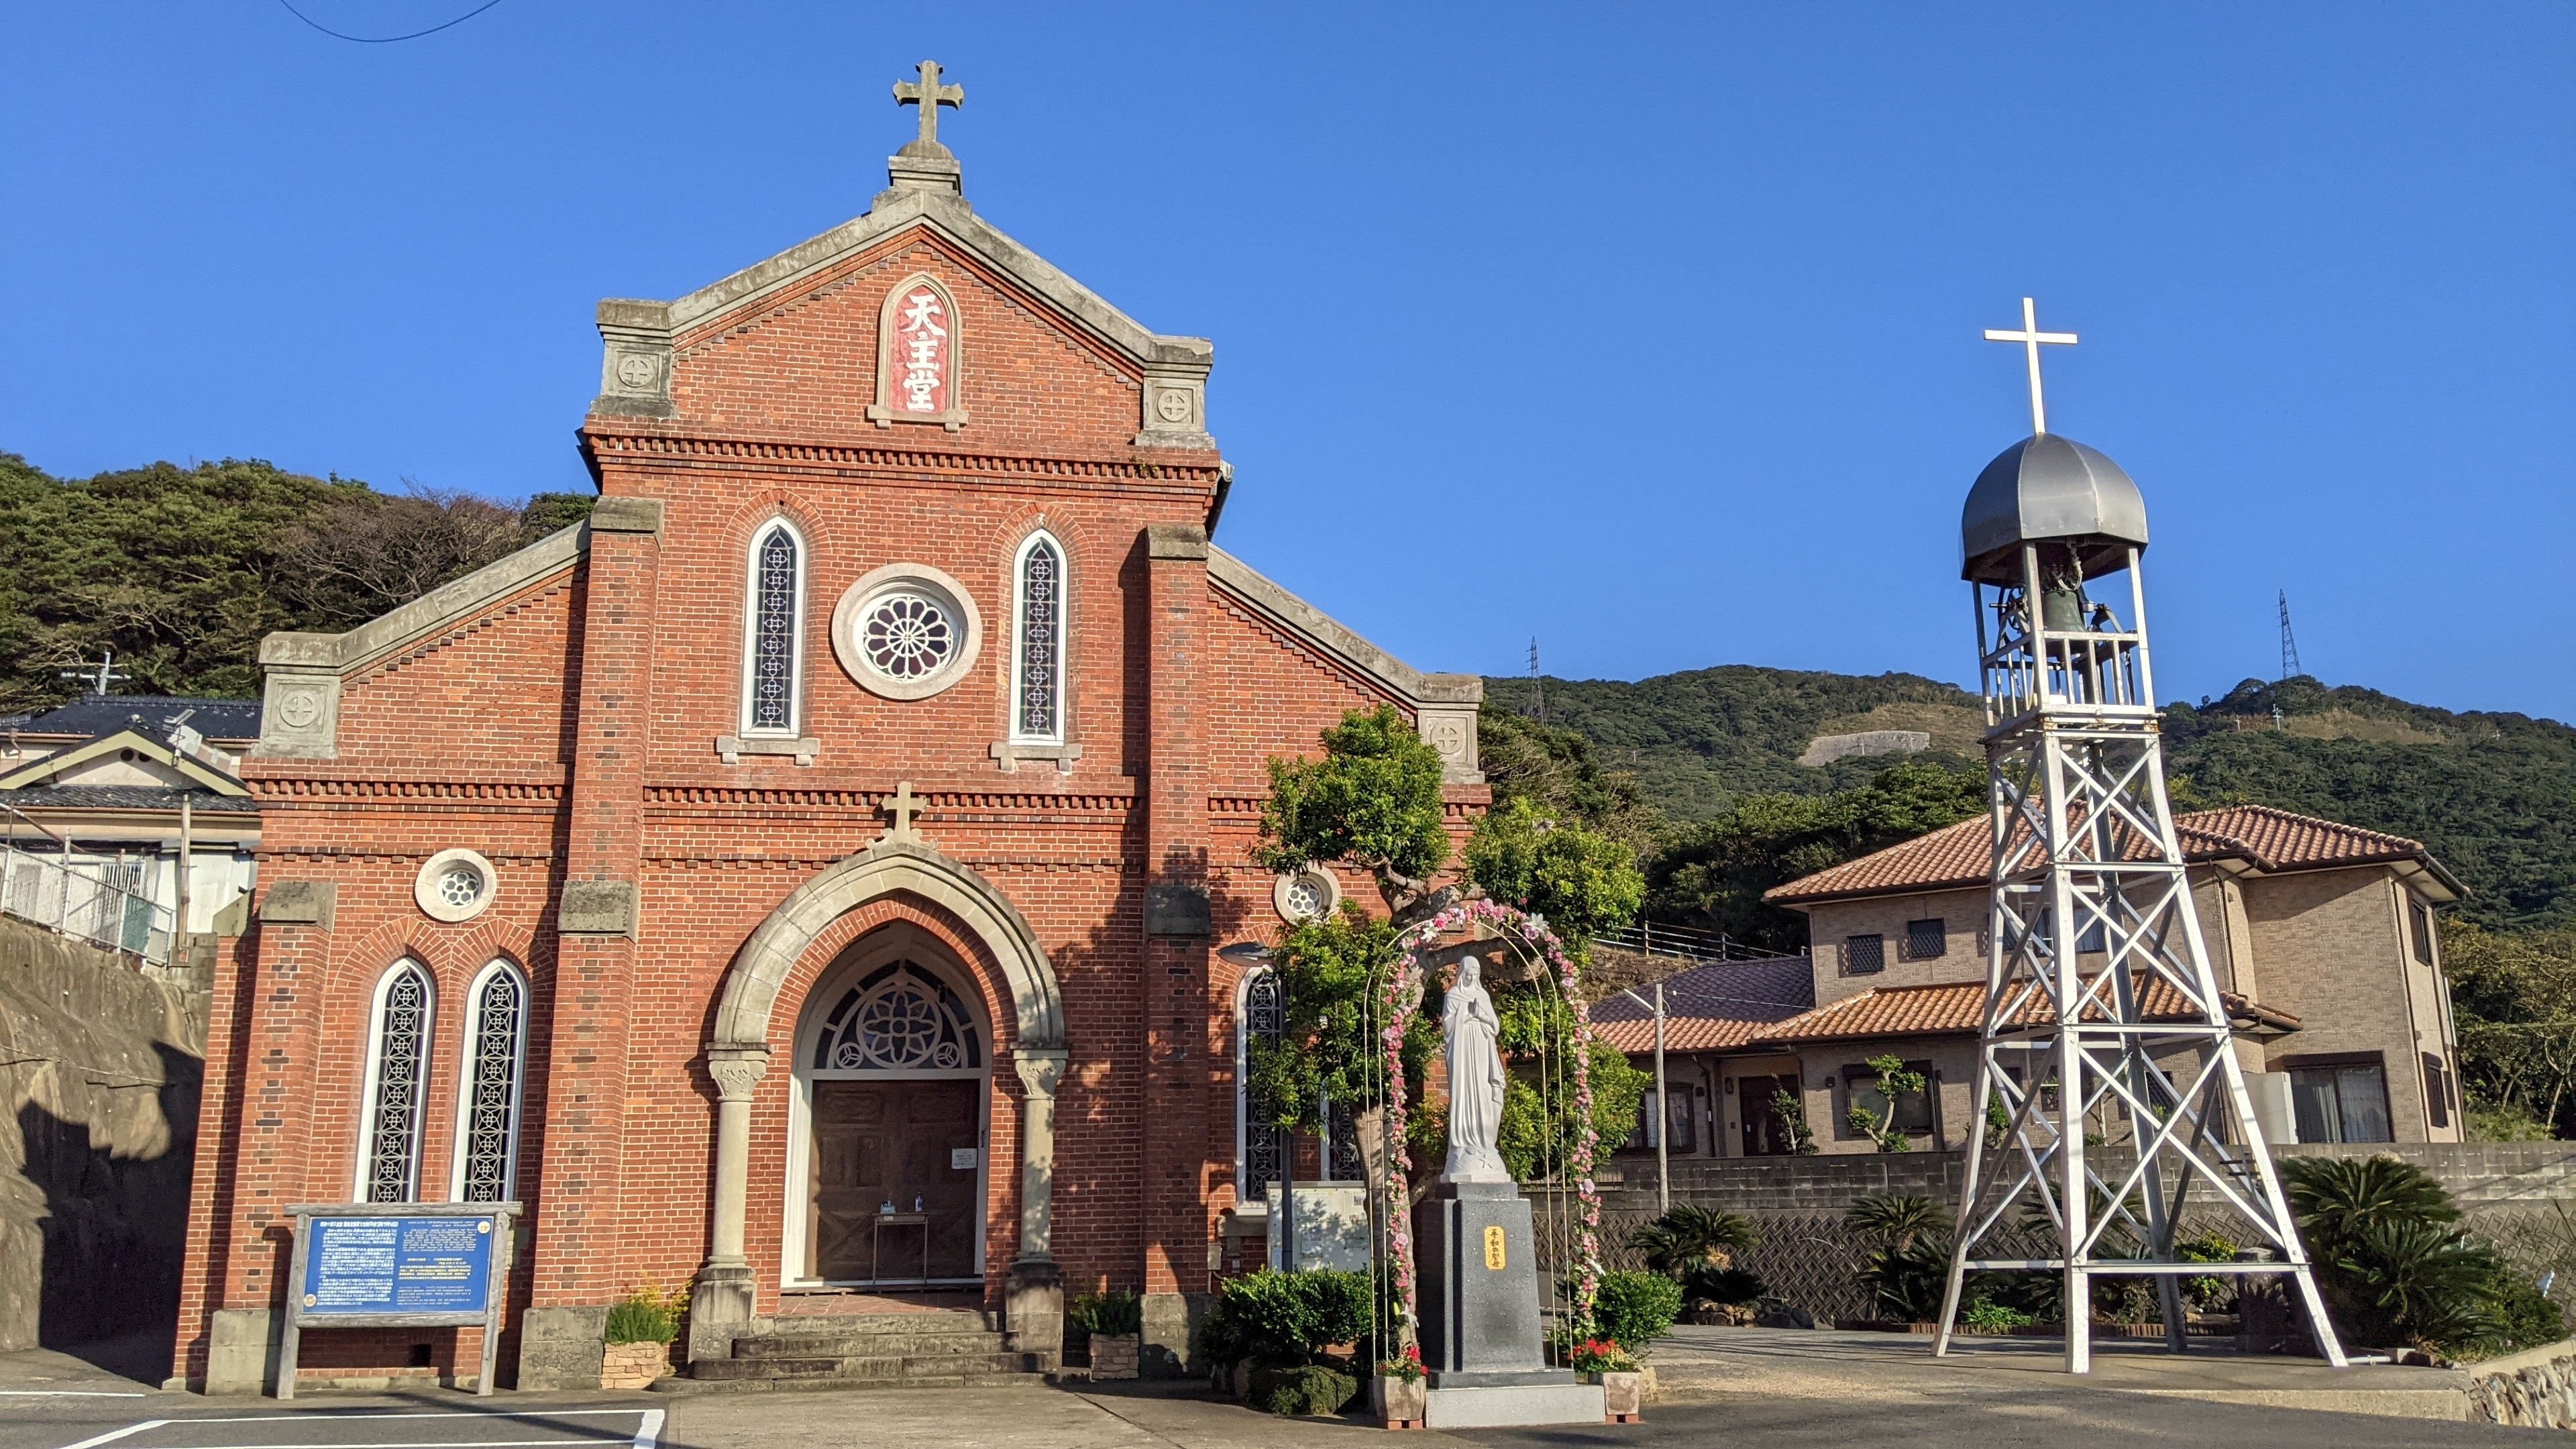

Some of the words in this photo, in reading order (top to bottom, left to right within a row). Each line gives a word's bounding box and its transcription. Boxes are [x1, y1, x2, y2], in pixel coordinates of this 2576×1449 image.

[900, 294, 947, 411] 天主堂
[1489, 1228, 1501, 1267] 平和の聖母
